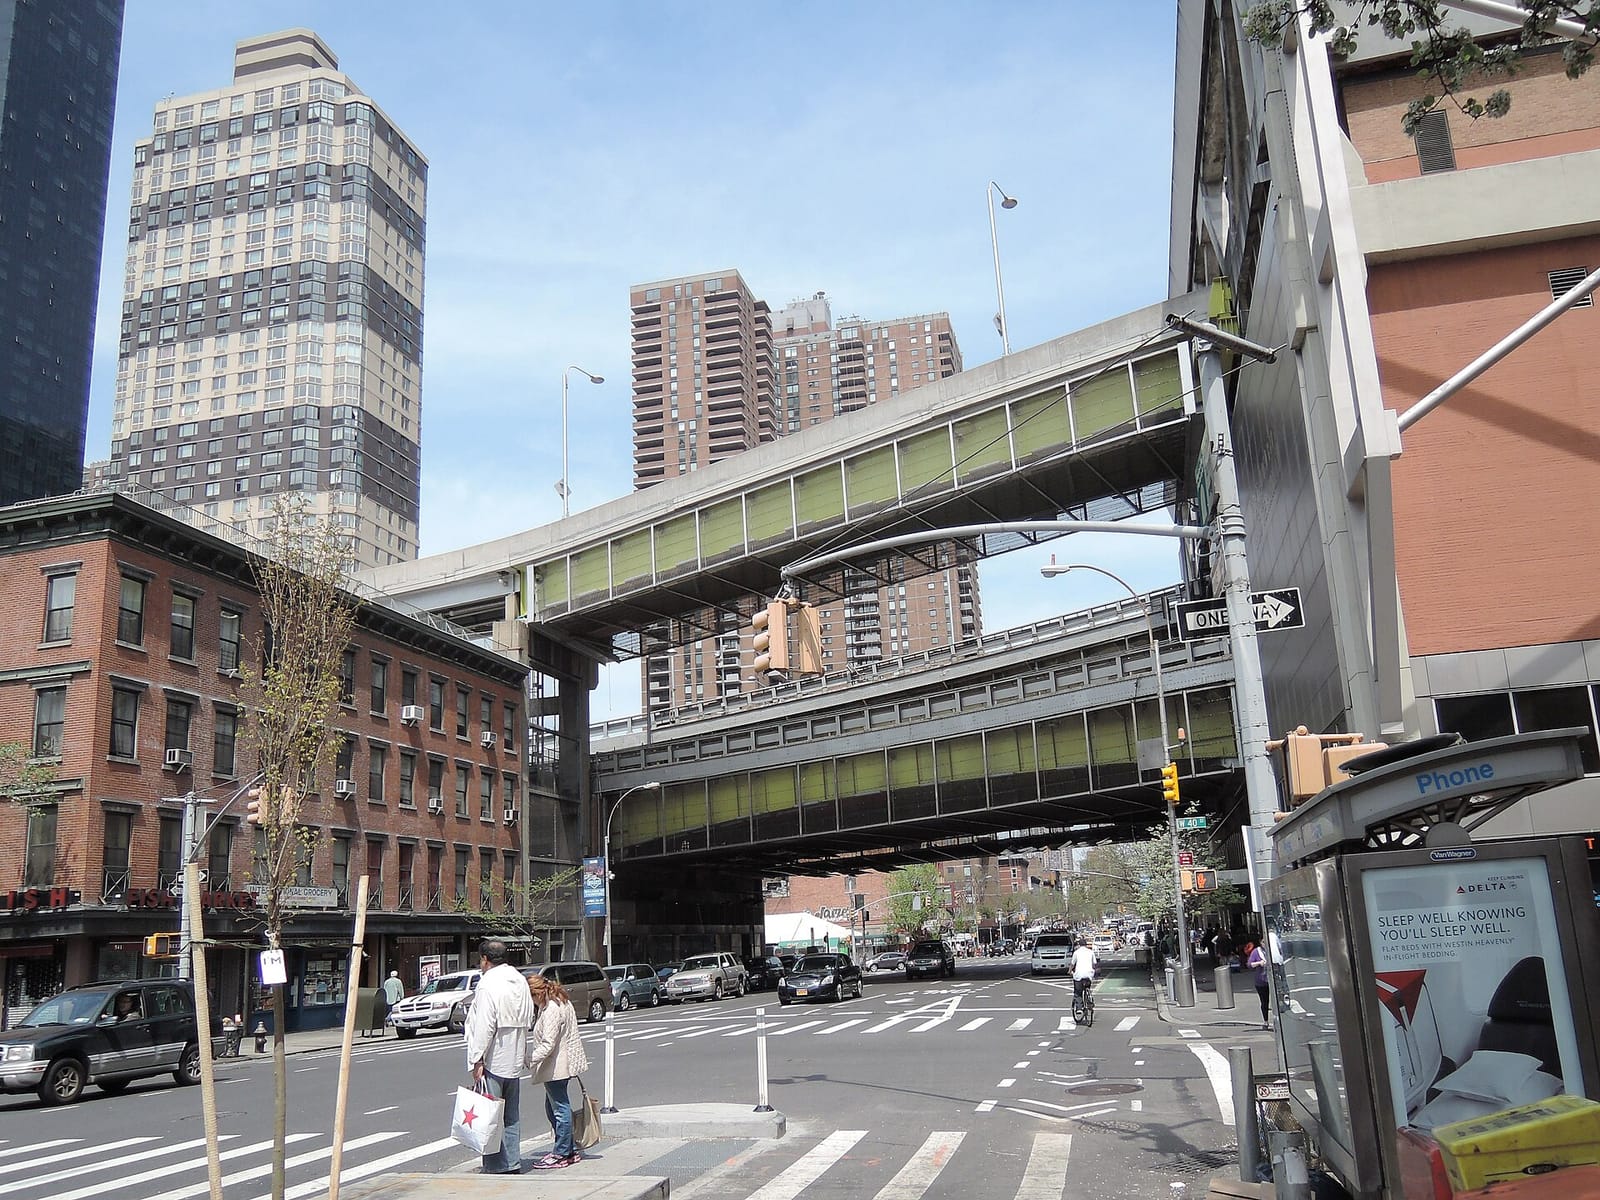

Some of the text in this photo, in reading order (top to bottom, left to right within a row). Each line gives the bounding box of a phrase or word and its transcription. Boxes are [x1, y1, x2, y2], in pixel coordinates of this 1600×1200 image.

[1196, 610, 1228, 627] ONE
[1415, 762, 1494, 794] Phone
[1187, 819, 1198, 827] 40
[303, 889, 333, 897] GROCERY
[1468, 883, 1506, 892] DELTA
[127, 888, 258, 911] FISH ARKET
[1378, 907, 1526, 927] SLEEP WELL KNOWING
[1380, 923, 1511, 940] YOU'LL SLEEP WELL.
[1445, 940, 1473, 948] WESTIN
[1383, 952, 1420, 961] IN-FLIGHT
